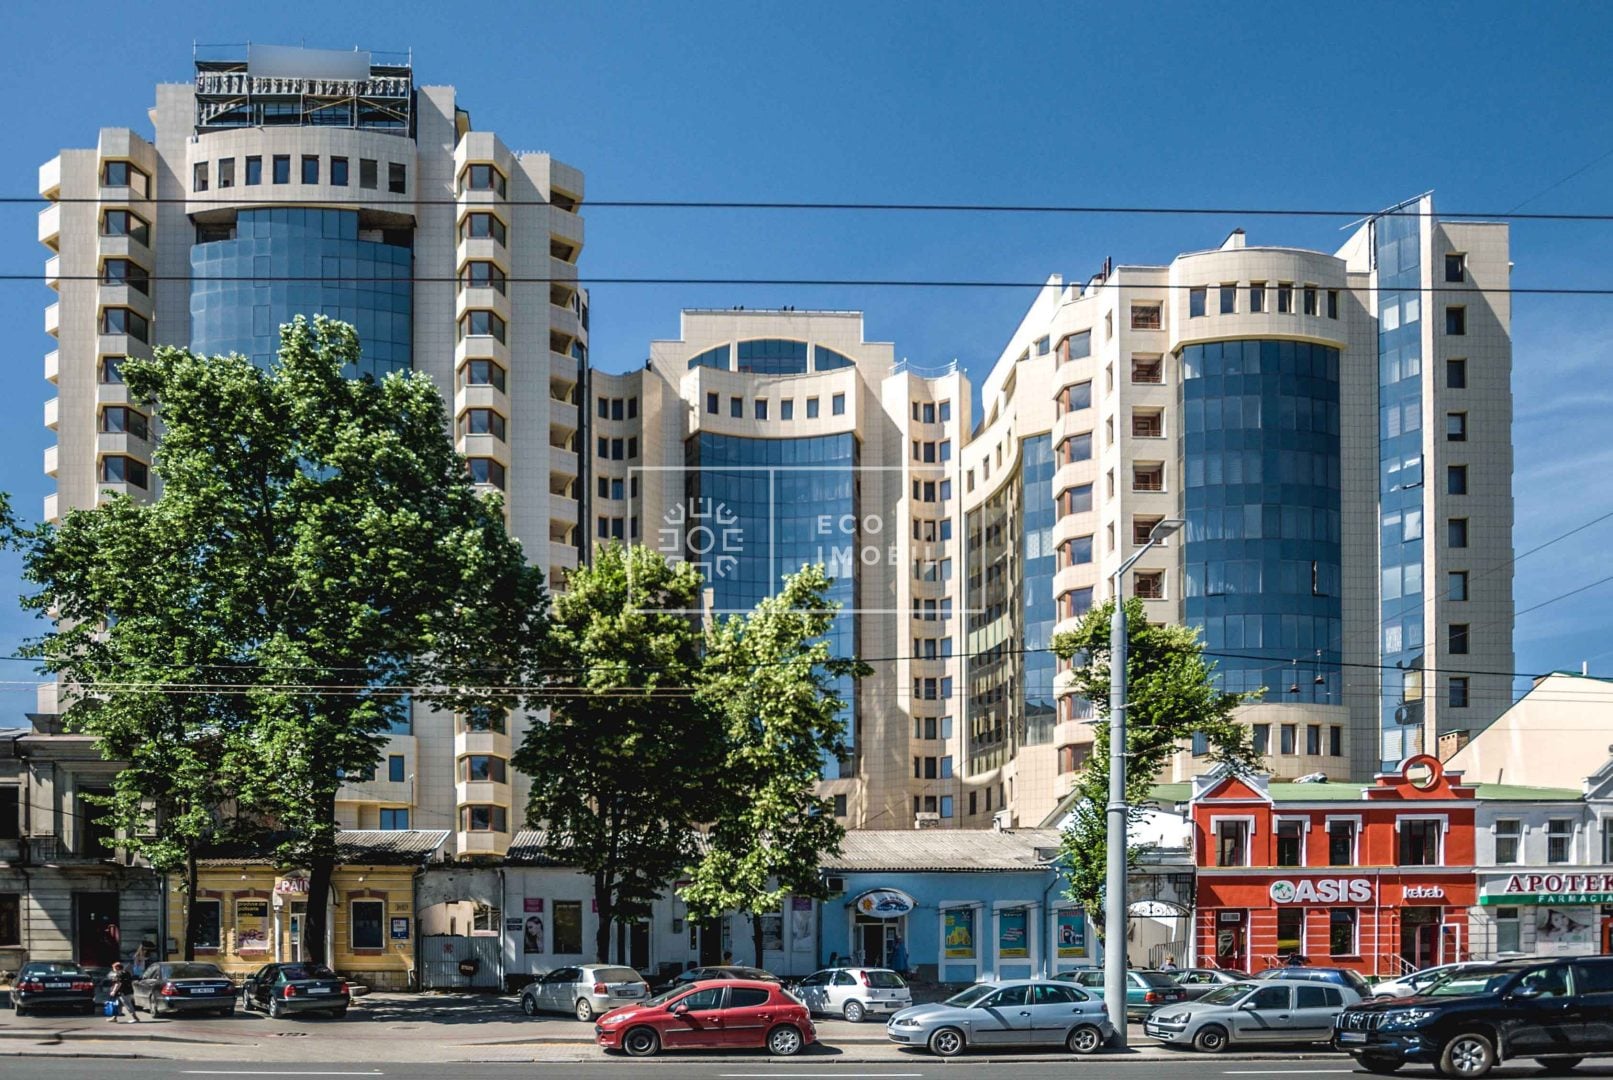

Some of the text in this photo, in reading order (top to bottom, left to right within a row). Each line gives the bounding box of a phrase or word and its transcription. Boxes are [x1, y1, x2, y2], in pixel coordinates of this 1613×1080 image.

[1270, 879, 1371, 903] OASIS
[1402, 885, 1444, 899] kebab
[1538, 894, 1613, 903] FARMACIA
